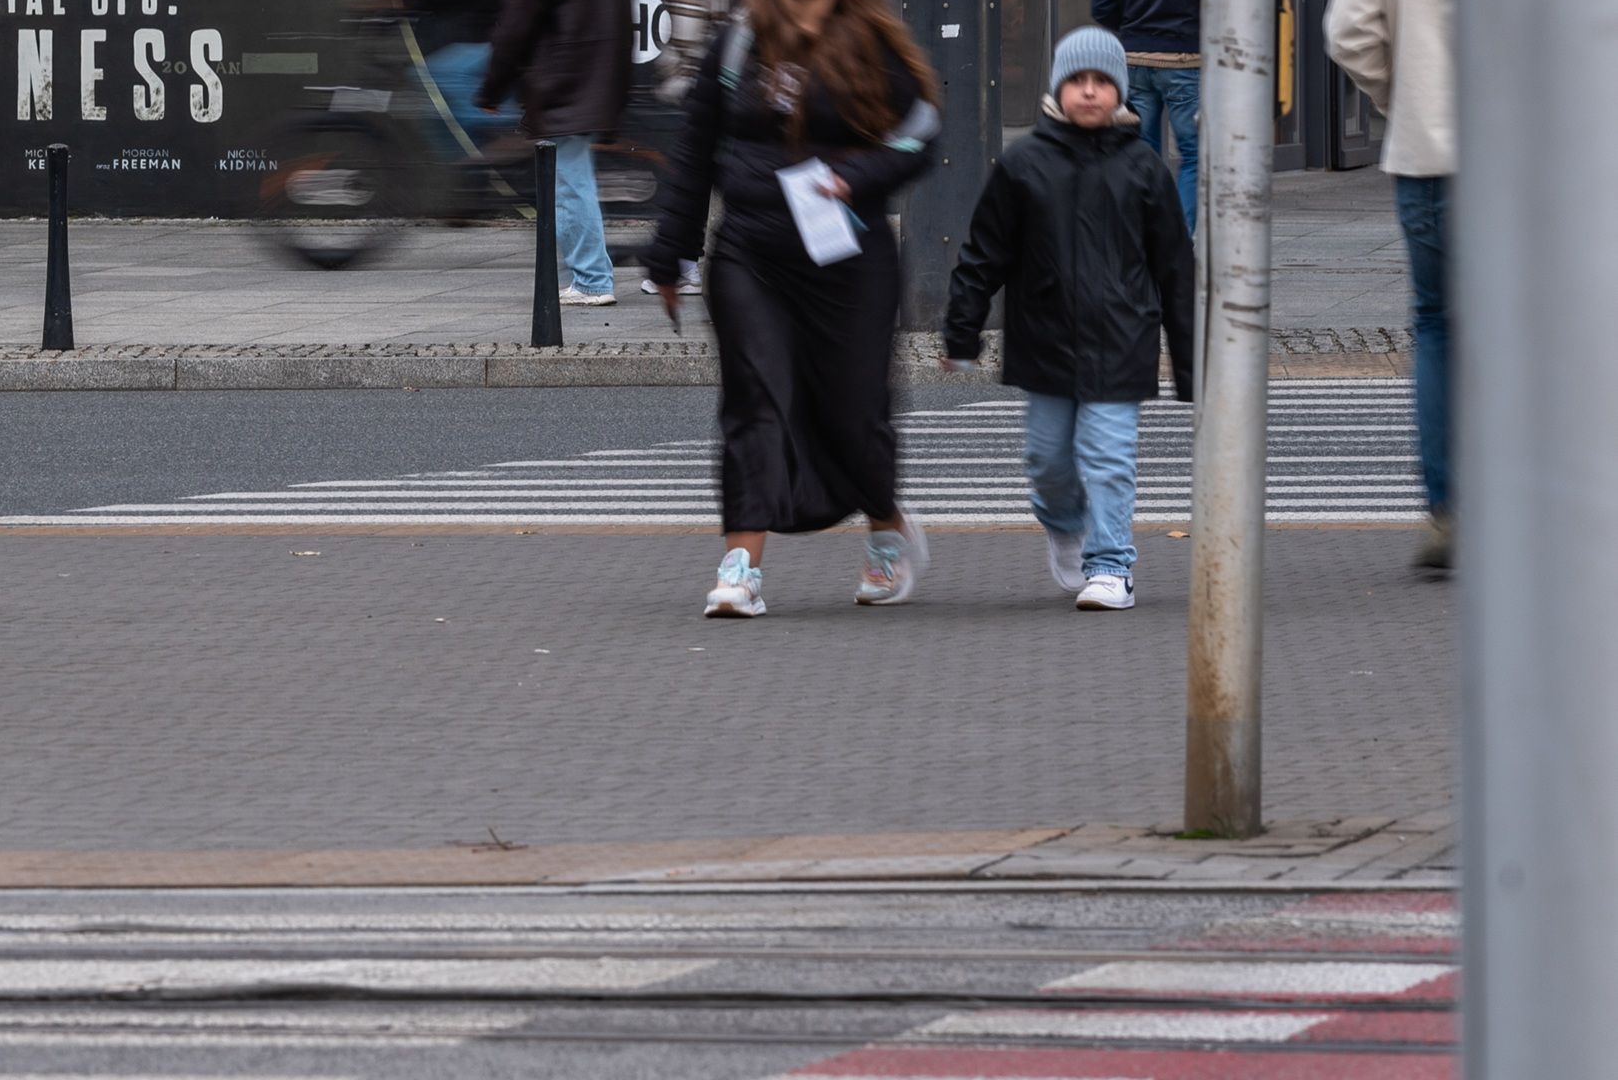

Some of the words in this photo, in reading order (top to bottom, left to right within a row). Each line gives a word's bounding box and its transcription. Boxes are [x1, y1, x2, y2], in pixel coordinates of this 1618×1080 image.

[122, 148, 170, 158] MORGAN
[227, 149, 268, 159] NICOLE
[113, 158, 181, 170] FREEMAN
[219, 159, 279, 171] KIDMAN
